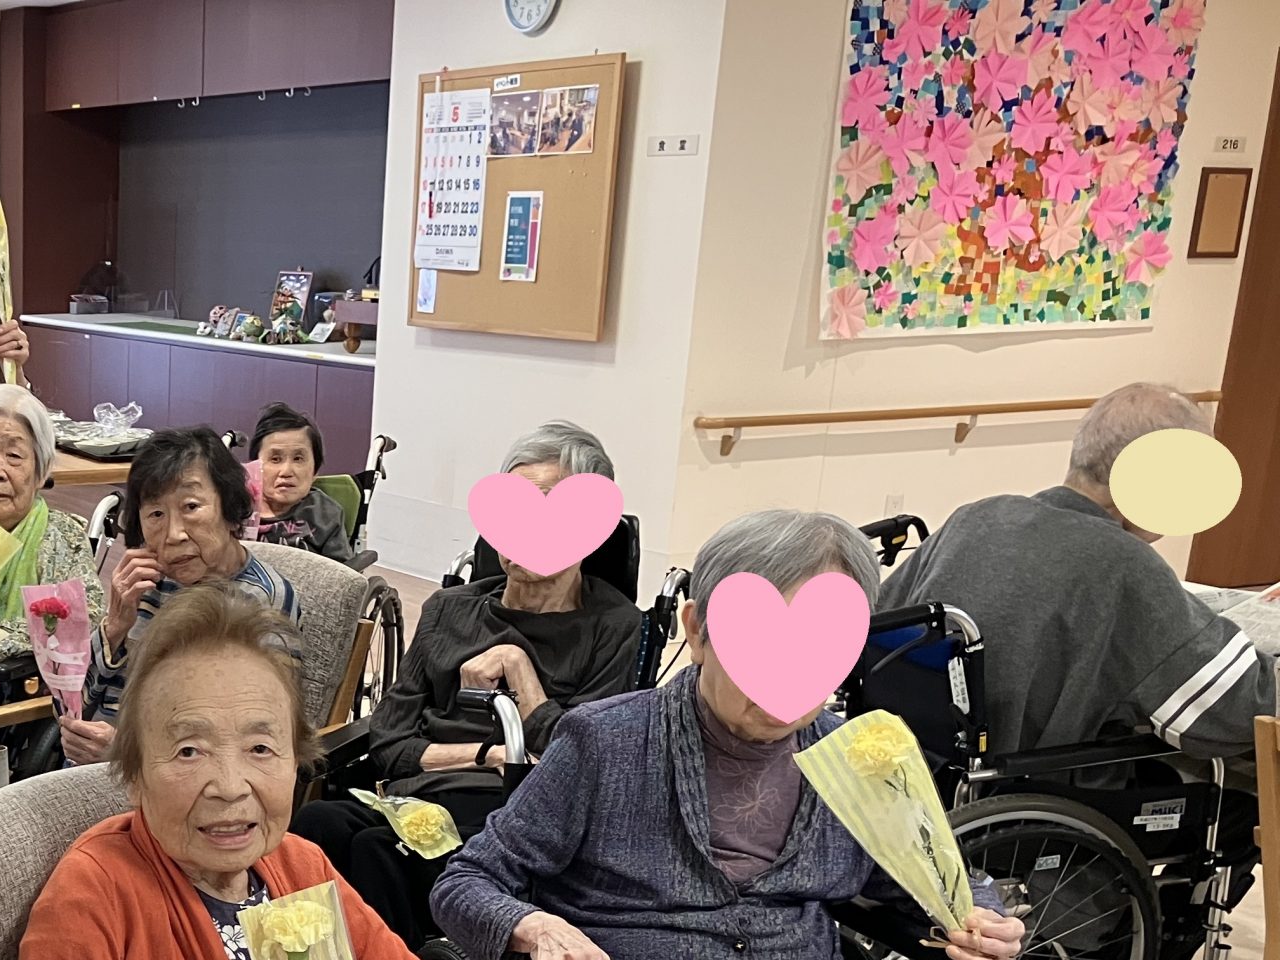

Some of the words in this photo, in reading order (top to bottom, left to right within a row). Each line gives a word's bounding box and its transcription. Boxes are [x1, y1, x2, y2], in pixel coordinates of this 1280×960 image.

[451, 105, 460, 123] 5
[1222, 138, 1239, 150] 216
[463, 178, 470, 191] 15
[472, 178, 480, 191] 16
[444, 201, 451, 214] 20
[452, 201, 460, 214] 21
[460, 201, 469, 214] 22
[470, 201, 479, 214] 23
[425, 224, 433, 236] 25
[434, 224, 441, 236] 26
[442, 224, 450, 237] 27
[450, 224, 458, 237] 28
[459, 224, 467, 237] 29
[468, 224, 478, 237] 30
